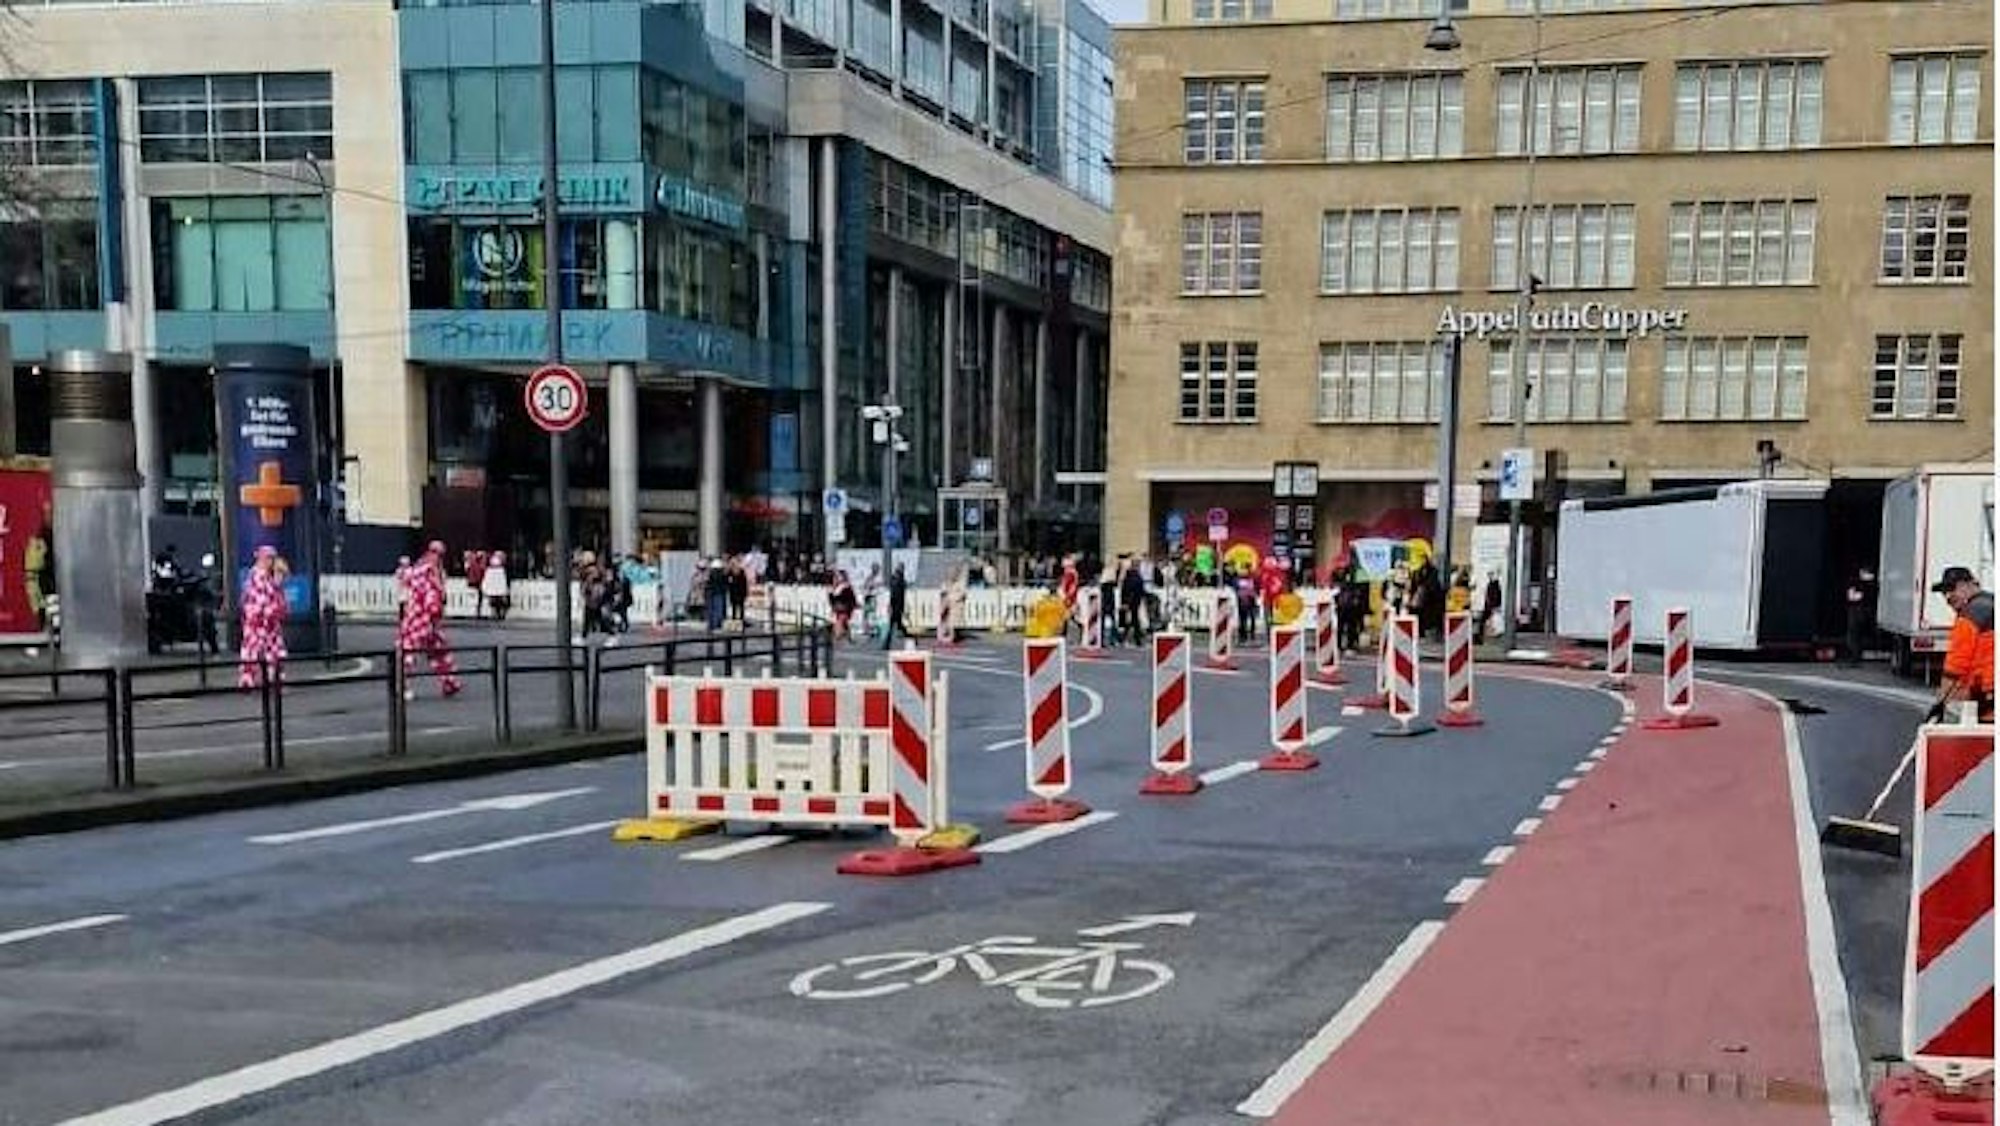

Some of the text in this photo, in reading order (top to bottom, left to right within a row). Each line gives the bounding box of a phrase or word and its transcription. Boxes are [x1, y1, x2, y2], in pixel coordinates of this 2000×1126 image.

[524, 174, 631, 202] KINIK
[1437, 302, 1689, 339] AppelathCüpper
[438, 320, 615, 352] PRIMRK
[541, 385, 572, 410] 30
